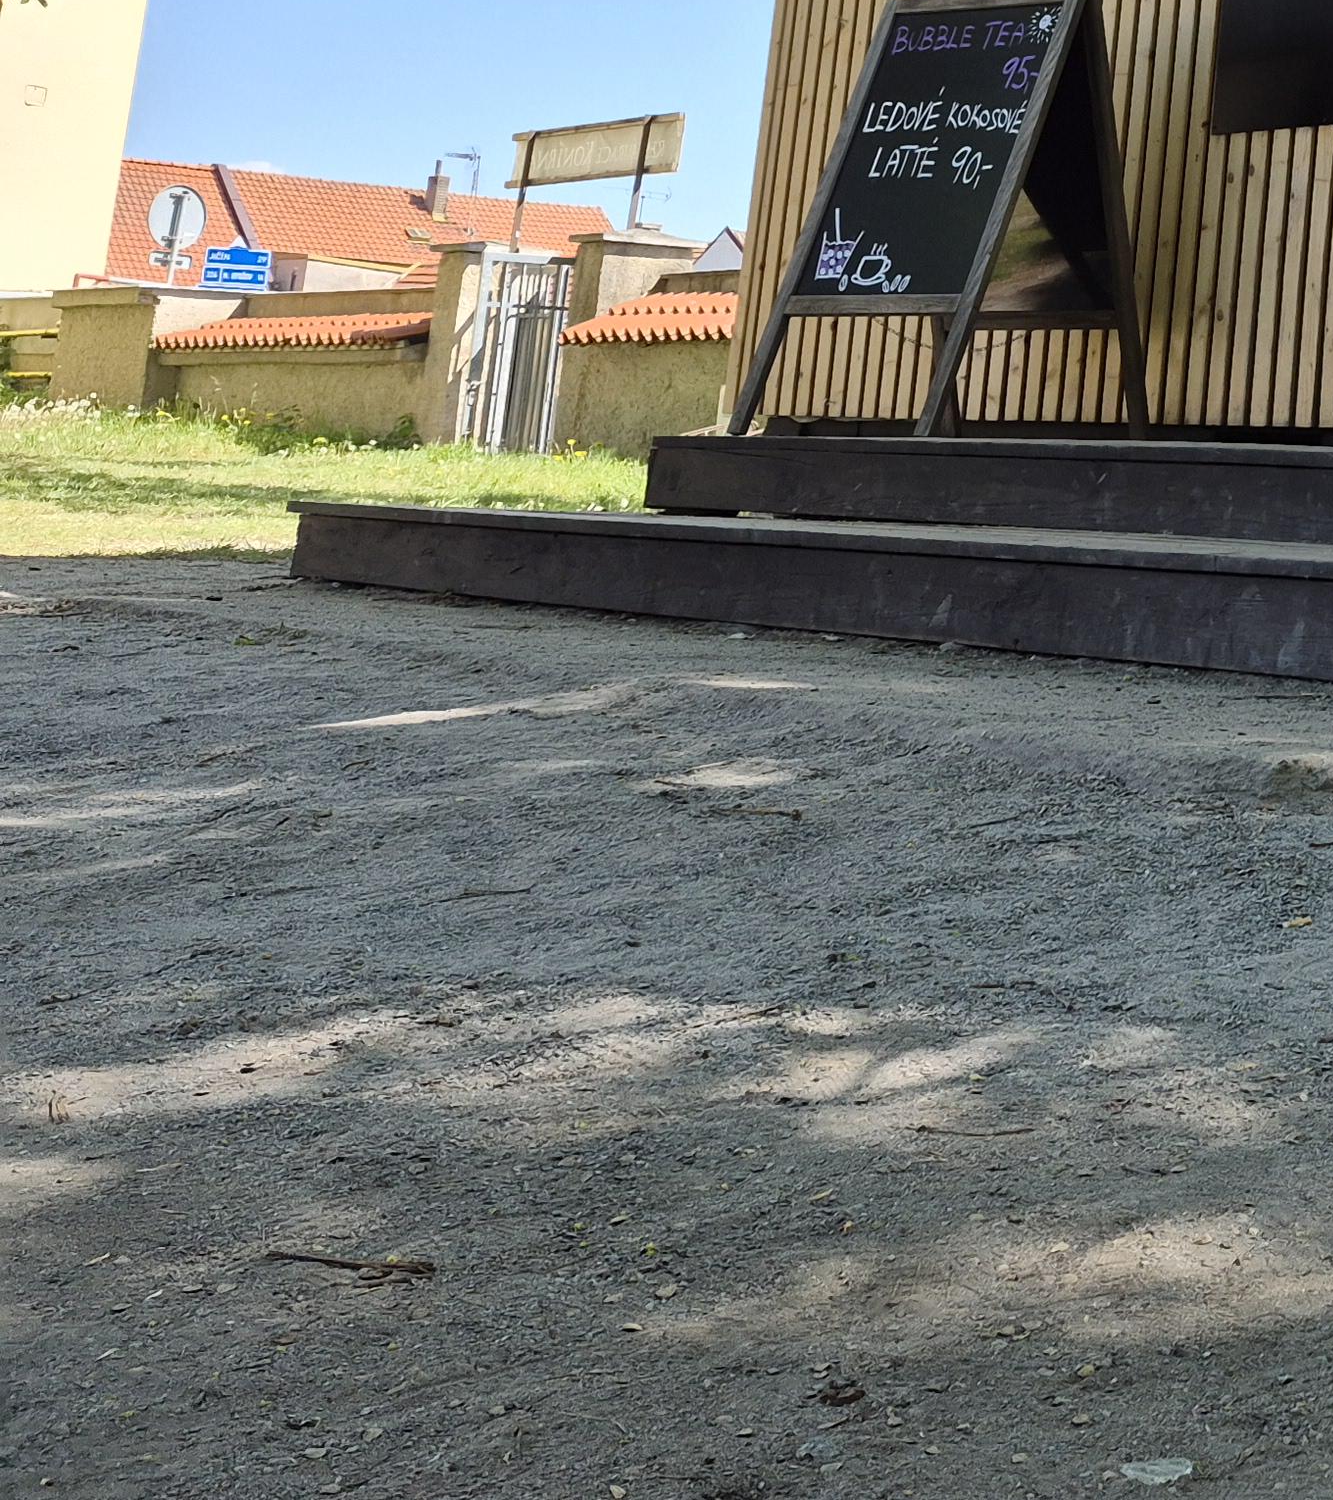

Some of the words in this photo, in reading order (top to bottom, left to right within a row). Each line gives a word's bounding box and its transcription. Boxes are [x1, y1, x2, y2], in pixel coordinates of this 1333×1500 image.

[892, 25, 975, 55] BUBBLE
[983, 21, 1025, 50] TEA
[863, 86, 945, 133] LEDOVÉ
[945, 100, 1028, 134] KOKOSOVÉ
[951, 146, 993, 190] 90,-
